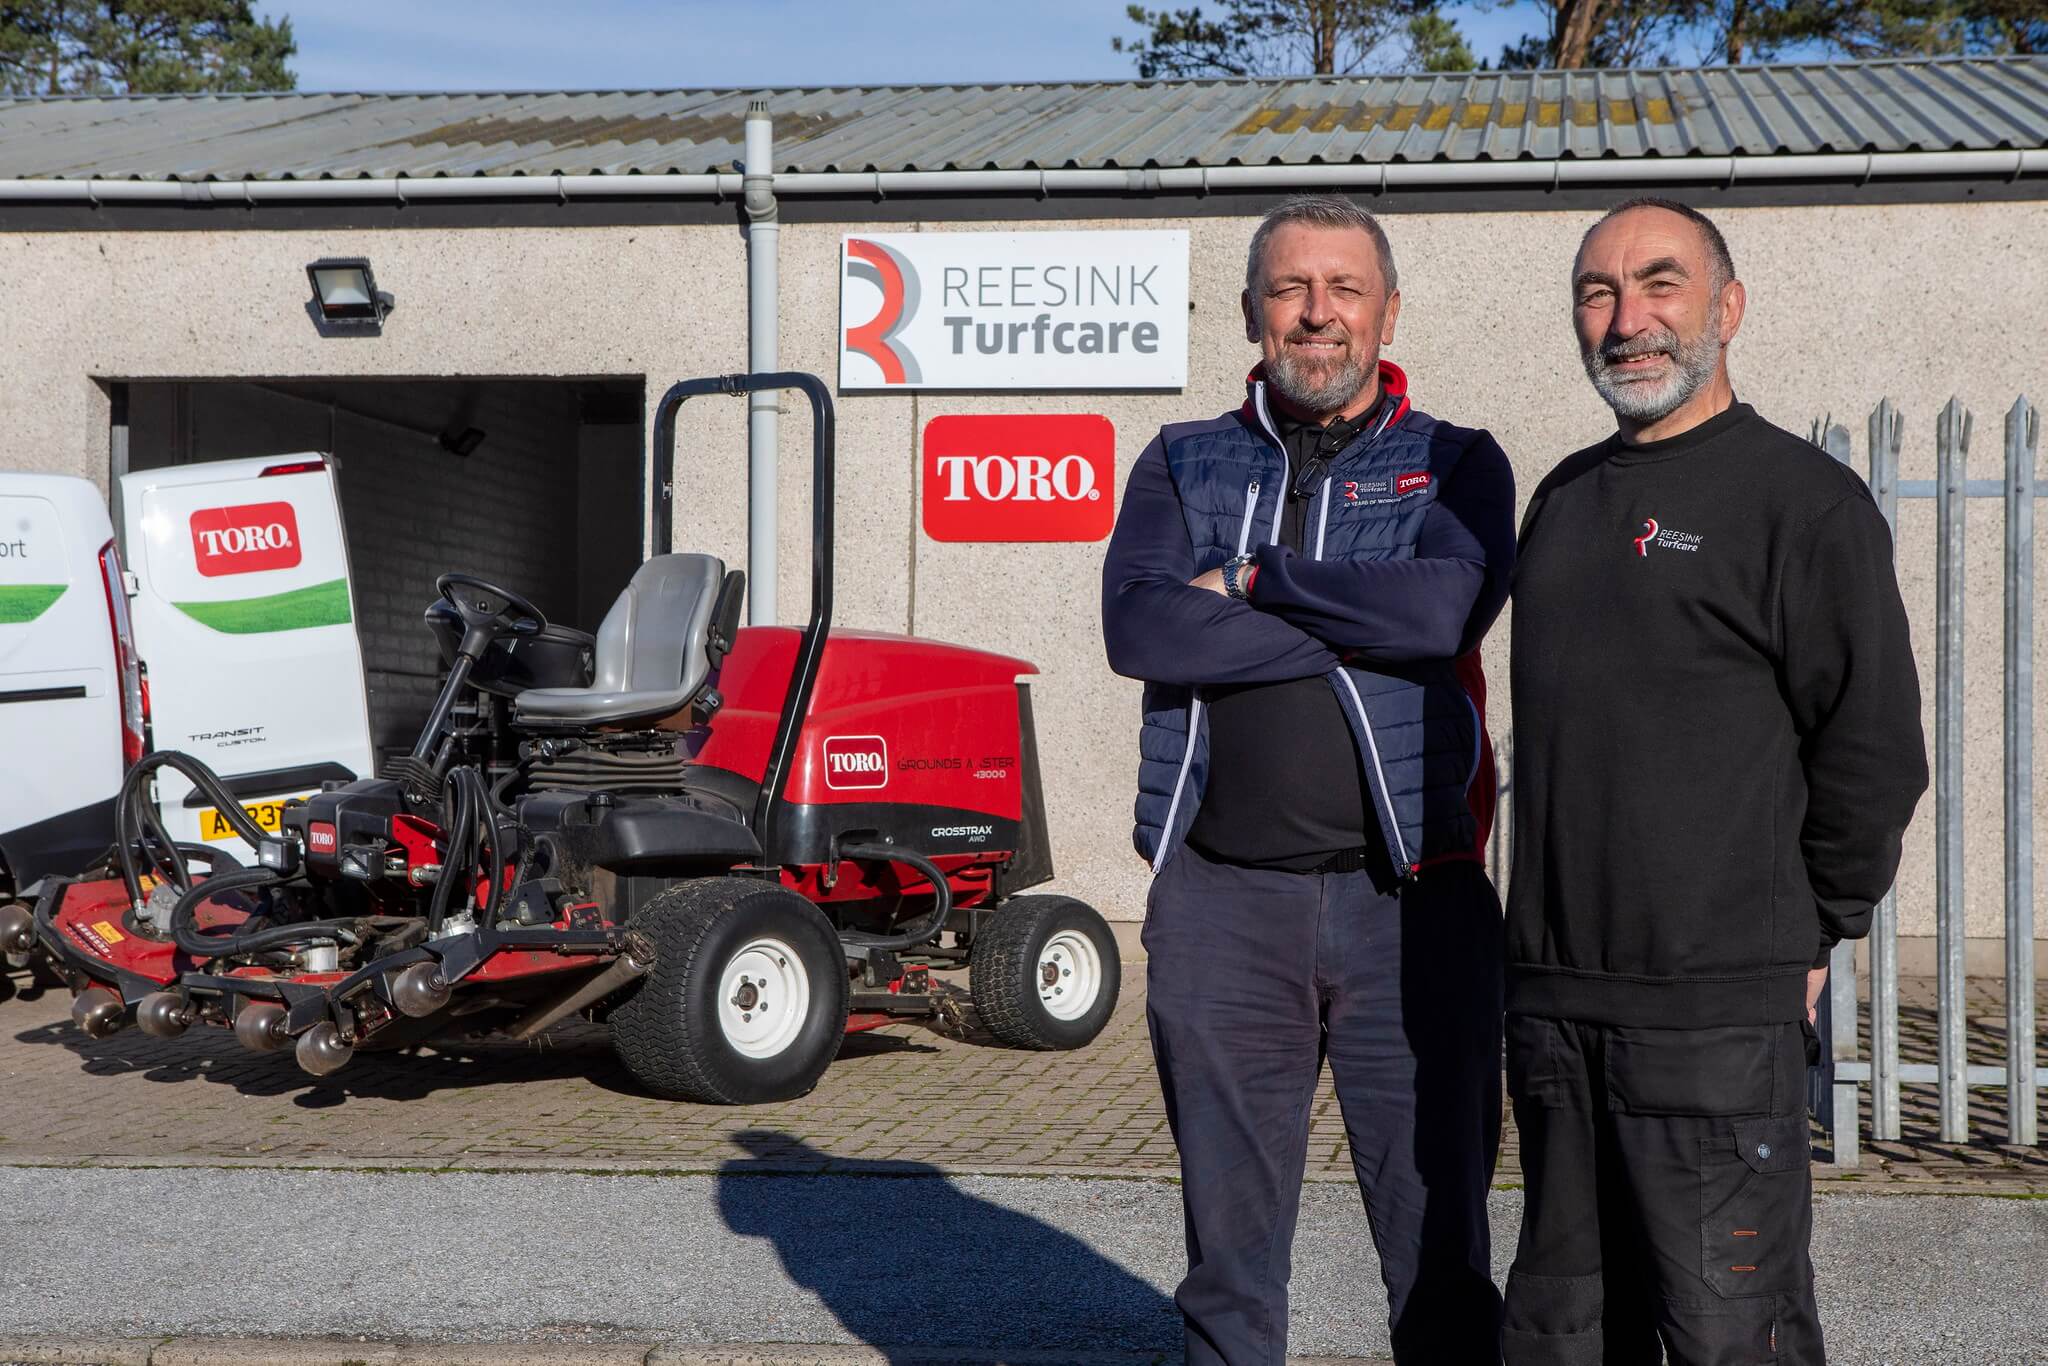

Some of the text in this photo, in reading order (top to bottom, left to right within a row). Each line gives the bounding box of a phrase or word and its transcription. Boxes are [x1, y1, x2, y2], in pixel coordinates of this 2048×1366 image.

[943, 264, 1159, 307] REESINK
[943, 313, 1159, 355] Turfcare
[937, 454, 1096, 501] TORO
[1400, 475, 1426, 489] TORO
[200, 522, 289, 557] TORO
[1659, 529, 1704, 544] REESINK
[1657, 537, 1699, 552] Turfcare
[188, 726, 265, 742] TRANSIT
[217, 737, 266, 748] CUSTOM
[830, 751, 884, 773] TORO
[311, 831, 333, 845] TORO
[931, 825, 993, 838] CROSSTRAX
[968, 835, 986, 843] AWD
